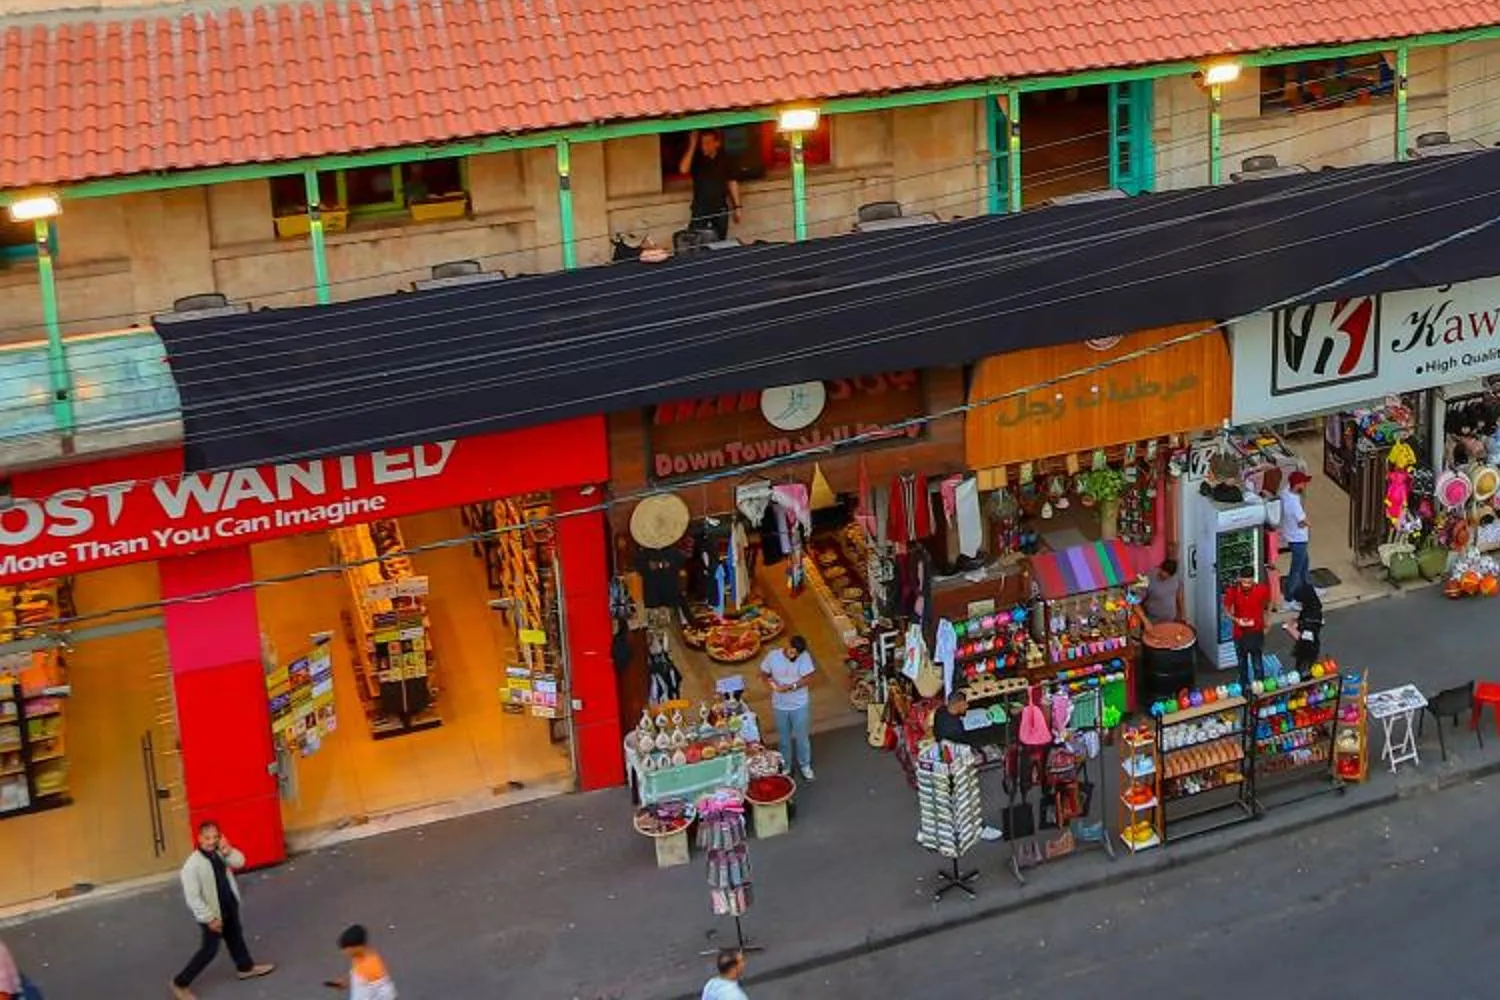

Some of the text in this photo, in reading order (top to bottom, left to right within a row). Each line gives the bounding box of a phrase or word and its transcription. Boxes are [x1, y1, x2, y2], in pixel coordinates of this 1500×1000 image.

[1425, 356, 1457, 374] High
[0, 439, 458, 547] OST WANTED
[72, 536, 149, 561] Than
[154, 523, 210, 550] You
[215, 514, 271, 537] Can
[275, 494, 387, 527] Imagine
